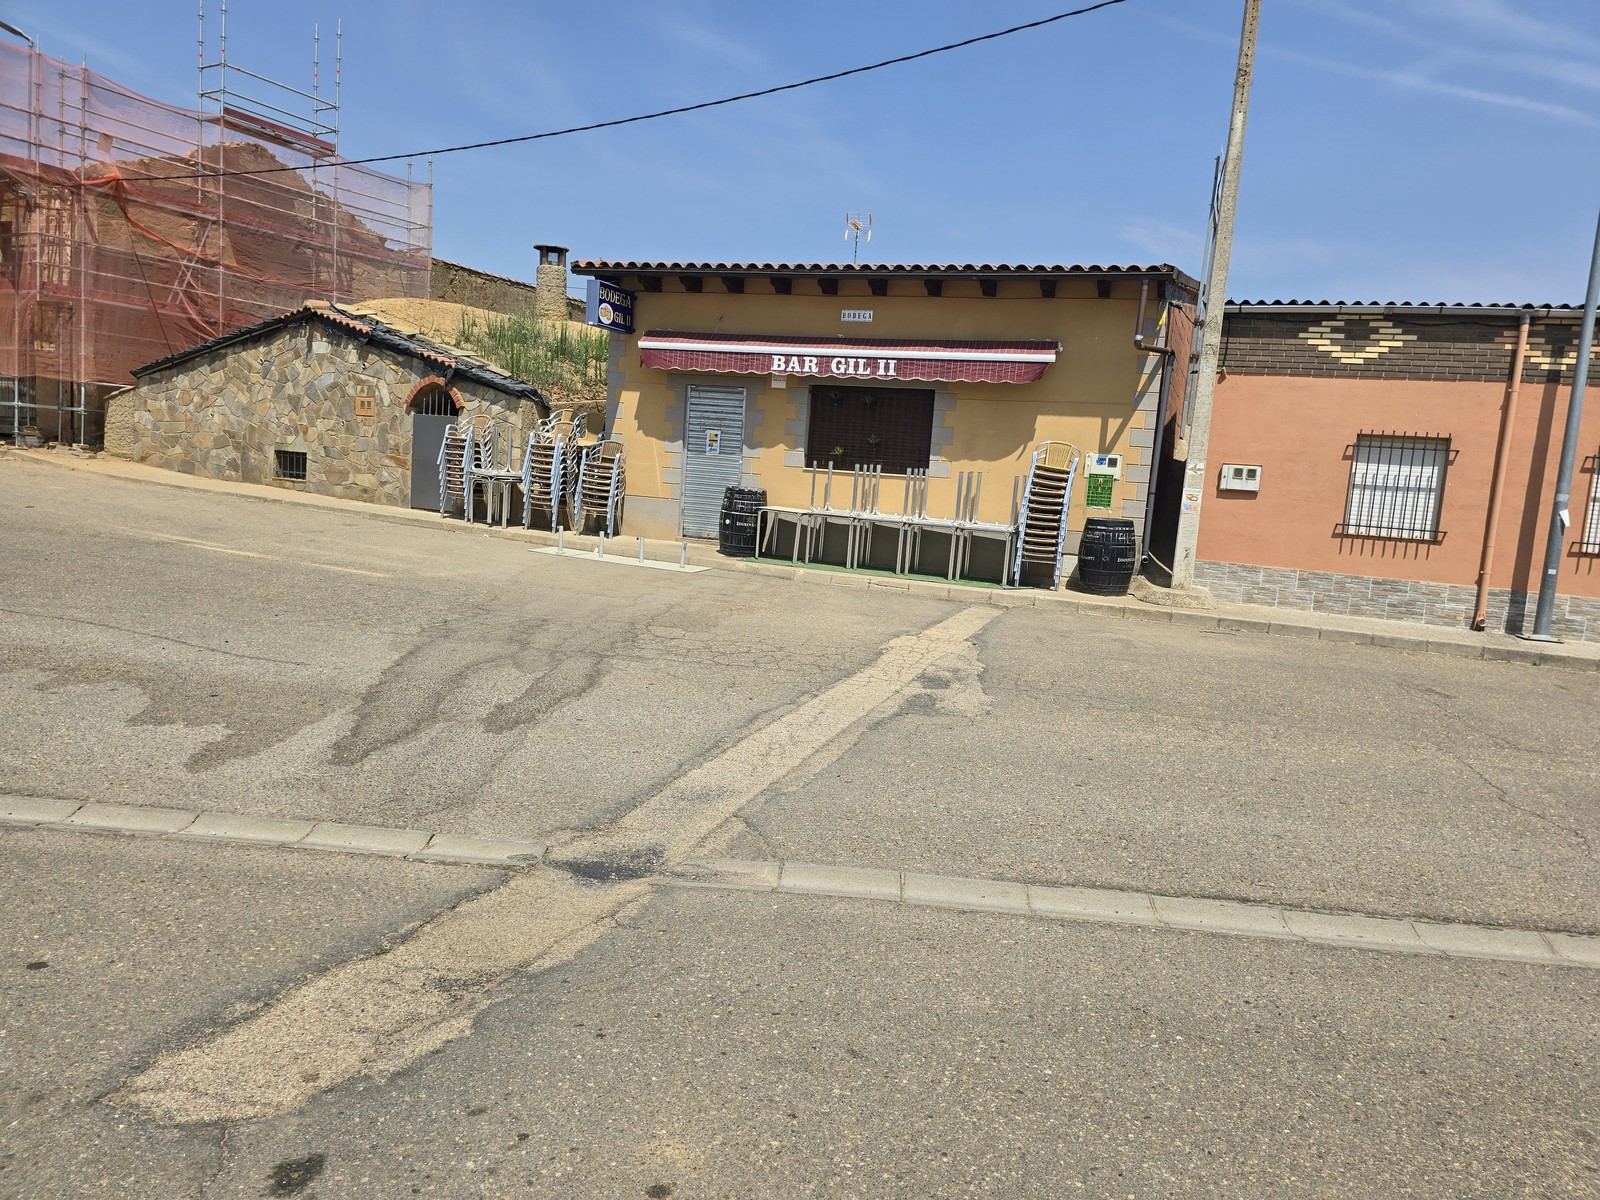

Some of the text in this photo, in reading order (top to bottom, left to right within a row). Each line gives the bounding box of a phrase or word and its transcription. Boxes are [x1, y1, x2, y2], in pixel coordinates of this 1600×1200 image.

[599, 286, 631, 308] BODEGA
[613, 311, 625, 325] GIL
[842, 312, 872, 320] BODEGA
[771, 354, 898, 376] BAR GIL II
